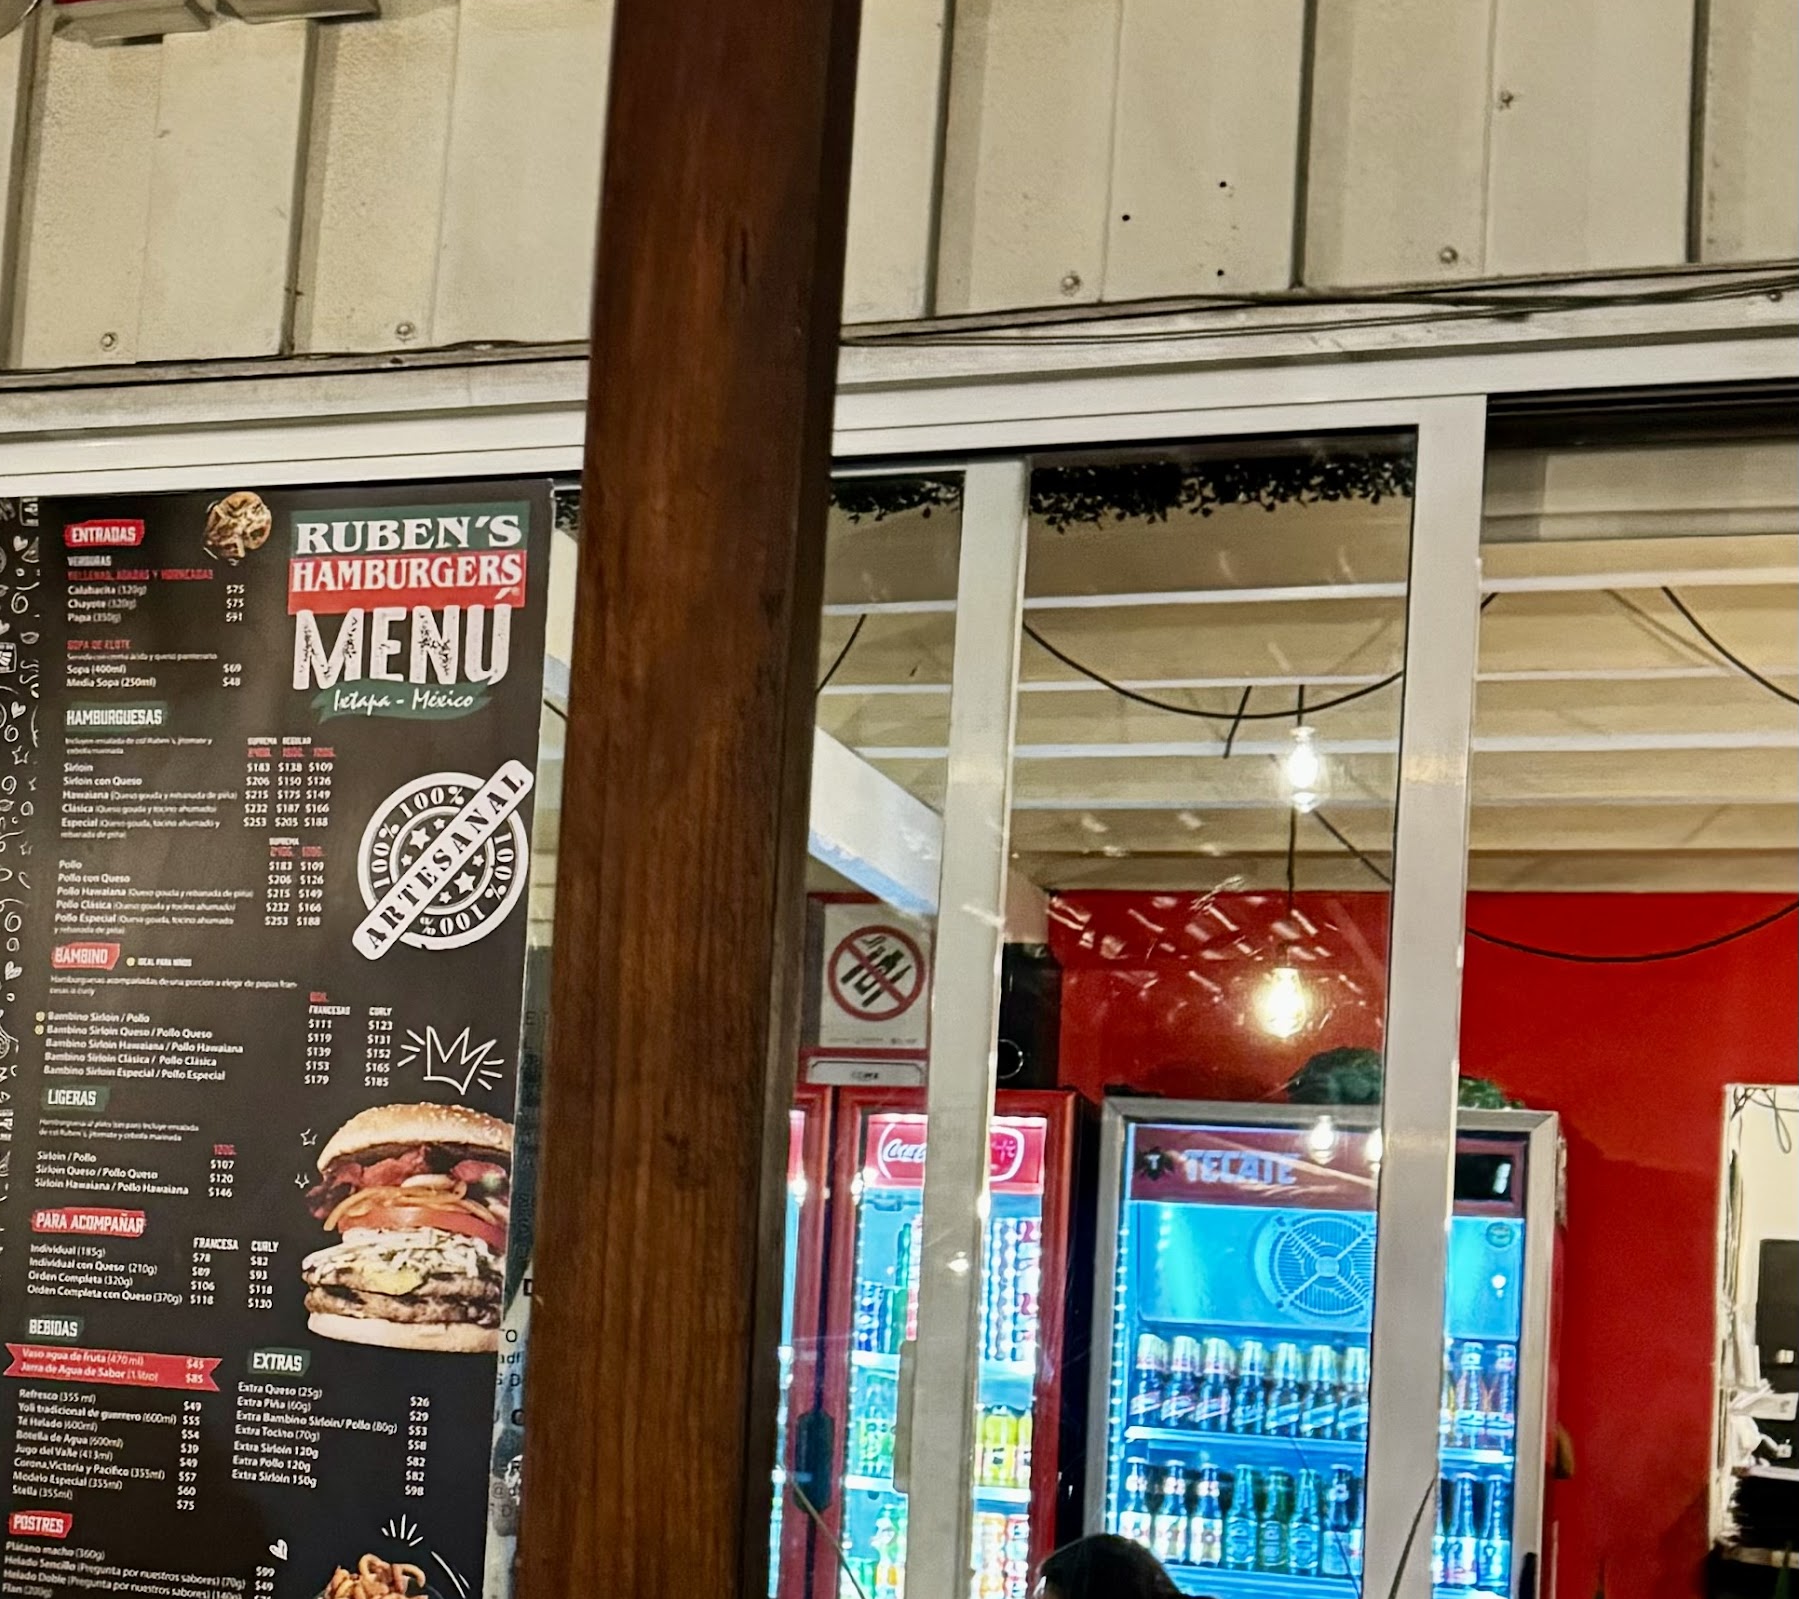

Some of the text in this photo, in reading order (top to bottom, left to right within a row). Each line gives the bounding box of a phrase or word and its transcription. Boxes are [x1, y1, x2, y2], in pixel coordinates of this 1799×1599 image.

[71, 527, 136, 543] ENTRADAS
[296, 515, 522, 554] RUBEN'S
[291, 554, 523, 593] HAMBURGERS
[292, 587, 512, 690] MENÚ
[333, 688, 390, 716] Ixtapa
[412, 687, 473, 711] México
[66, 709, 162, 726] HAMBURGUESAS
[63, 762, 93, 773] Sirloin
[309, 762, 333, 772] $109
[63, 776, 93, 787] Sirloin
[94, 778, 110, 786] con
[112, 776, 142, 788] Queso
[246, 776, 270, 786] $206
[307, 776, 331, 786] $126
[245, 790, 269, 800] $215
[277, 790, 300, 800] $175
[306, 790, 331, 800] $149
[399, 786, 465, 818] 100%
[62, 803, 93, 814] Clásica
[276, 803, 300, 813] $187
[61, 817, 98, 829] Especial
[243, 817, 267, 827] $253
[365, 774, 525, 950] ARTESANAL
[371, 823, 400, 889] 100%
[59, 860, 82, 869] Pollo
[300, 861, 324, 871] $109
[485, 832, 515, 900] 100%
[58, 873, 81, 883] Pollo
[83, 875, 99, 883] con
[101, 873, 130, 884] Queso
[300, 875, 324, 885] $126
[57, 886, 80, 896] Pollo
[267, 888, 290, 898] $215
[299, 888, 323, 899] $149
[56, 899, 79, 910] Pollo
[80, 899, 112, 910] Clásica
[55, 913, 78, 923] Pollo
[80, 914, 116, 926] Especial
[265, 916, 288, 926] $253
[55, 948, 108, 964] BAMBINO
[48, 1011, 89, 1021] Bambino
[127, 1013, 150, 1023] Pollo
[309, 1019, 332, 1029] $111
[368, 1020, 393, 1030] $123
[48, 1089, 96, 1106] LIGERAS
[73, 1152, 97, 1163] Pollo
[211, 1159, 234, 1169] $107
[1184, 1148, 1298, 1185] TECATE
[67, 1166, 96, 1177] Queso
[210, 1173, 233, 1183] $120
[36, 1212, 145, 1233] PARA ACOMPAÑAR
[29, 1319, 78, 1337] BEBIDAS
[253, 1353, 303, 1372] EXTRAS
[49, 1474, 87, 1488] Especial
[177, 1485, 196, 1496] $60
[231, 1469, 257, 1481] Extra
[258, 1471, 290, 1484] Sirloin
[404, 1485, 424, 1496] $98
[13, 1514, 64, 1534] POSTRES
[2, 1583, 23, 1595] Flan
